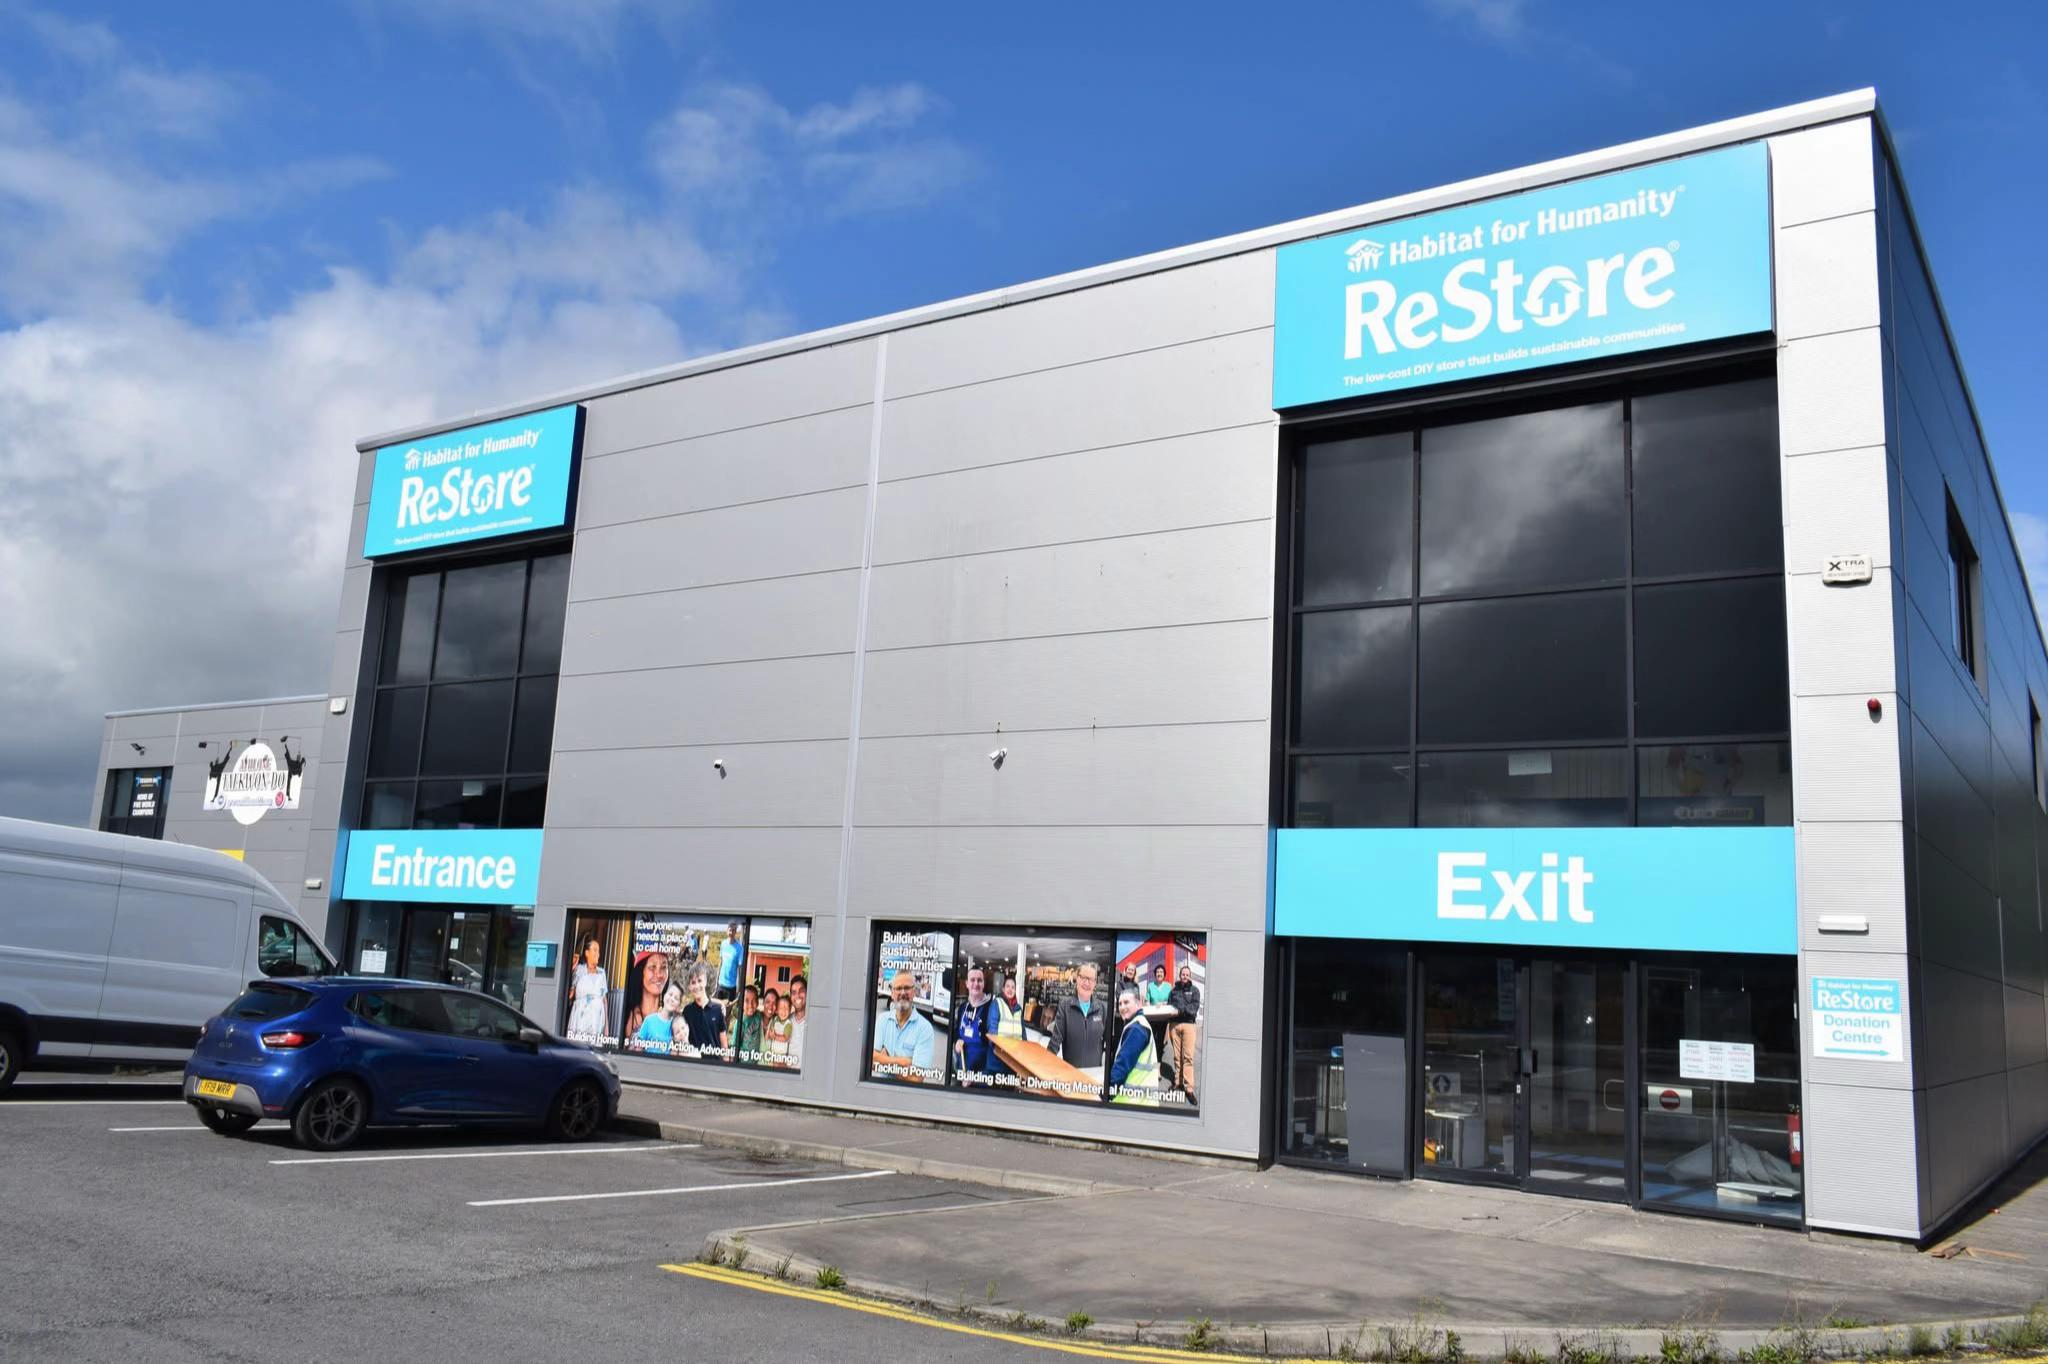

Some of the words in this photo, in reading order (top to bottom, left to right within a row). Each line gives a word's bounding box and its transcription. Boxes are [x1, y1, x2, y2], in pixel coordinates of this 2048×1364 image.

[1389, 226, 1483, 266] Habitat
[1491, 219, 1530, 245] for
[1537, 189, 1676, 236] Humanity
[1344, 247, 1676, 360] ReStore
[1343, 375, 1363, 387] The
[1365, 367, 1411, 383] low-cost
[1414, 362, 1434, 376] DIY
[1436, 357, 1466, 372] store
[1468, 352, 1492, 367] that
[1493, 346, 1529, 362] builds
[1531, 336, 1600, 357] sustainable
[1602, 322, 1687, 345] communities
[422, 448, 462, 468] Habitat
[465, 442, 481, 459] for
[483, 429, 540, 455] Humanity
[396, 466, 533, 529] ReStore
[371, 843, 517, 890] Entrance
[1437, 851, 1594, 923] Exit
[637, 920, 673, 932] Everyone
[637, 932, 659, 941] needs
[667, 932, 687, 943] place
[882, 931, 923, 947] Building
[636, 943, 644, 952] to
[645, 943, 658, 952] call
[659, 943, 681, 953] home
[881, 945, 939, 959] sustainable
[881, 959, 946, 972] communities
[1817, 990, 1894, 1010] ReStore
[1824, 1014, 1890, 1029] Donation
[567, 1030, 596, 1045] Building
[635, 1038, 667, 1052] Inspiring
[668, 1041, 694, 1053] Action
[751, 1049, 763, 1061] for
[764, 1051, 798, 1066] Change
[1832, 1030, 1883, 1044] Centre
[873, 1062, 909, 1077] Tackling
[910, 1064, 945, 1080] Poverty
[957, 1070, 993, 1085] Building
[995, 1073, 1020, 1087] Skills
[1028, 1077, 1071, 1093] Diverting
[1119, 1086, 1144, 1098] from
[1146, 1089, 1185, 1103] Landfill
